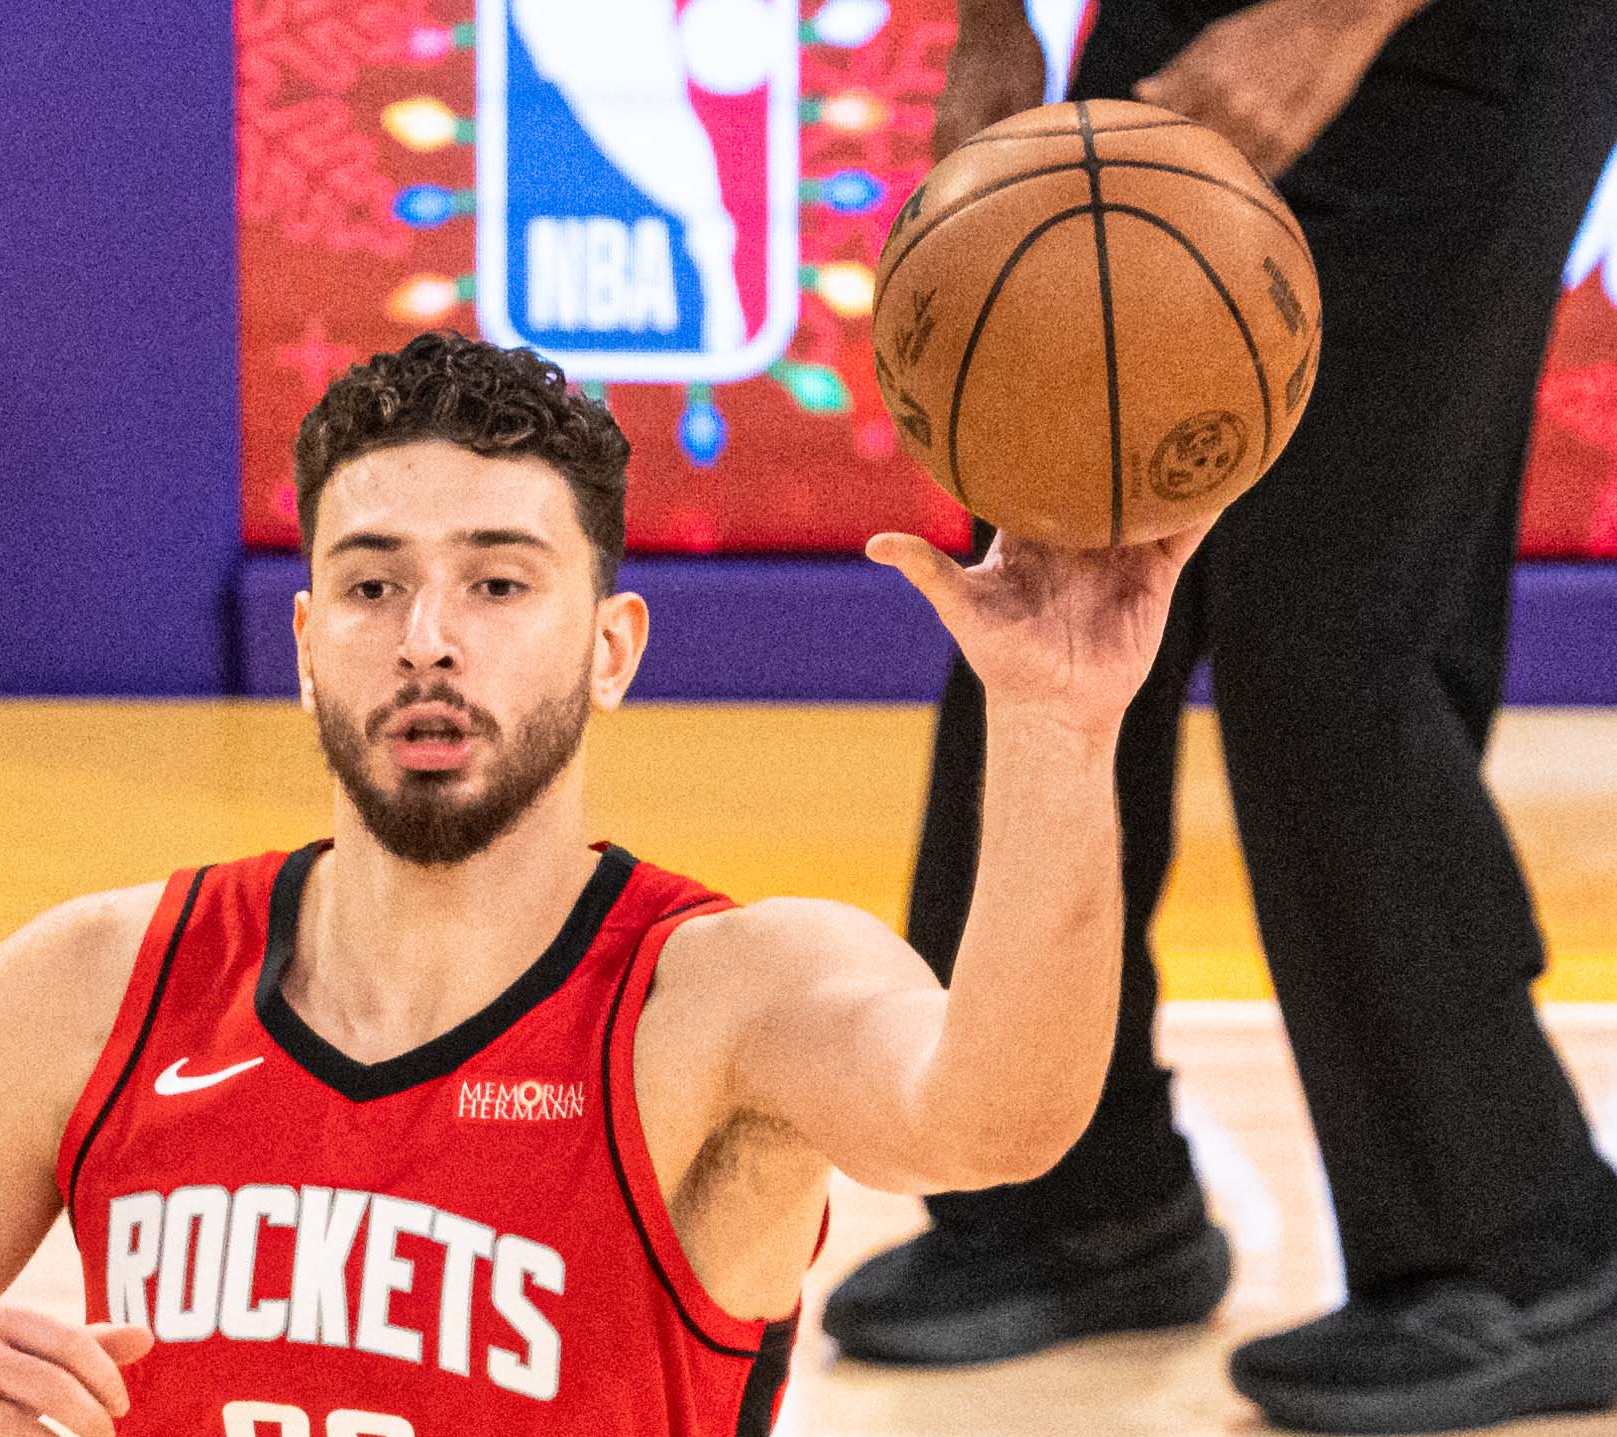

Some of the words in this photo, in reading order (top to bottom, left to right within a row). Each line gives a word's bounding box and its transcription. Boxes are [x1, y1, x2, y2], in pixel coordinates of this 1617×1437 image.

[527, 216, 678, 332] NBA
[458, 1099, 583, 1120] HERMANN
[461, 1080, 584, 1105] MEMORIAL
[106, 1184, 566, 1401] ROCKETS
